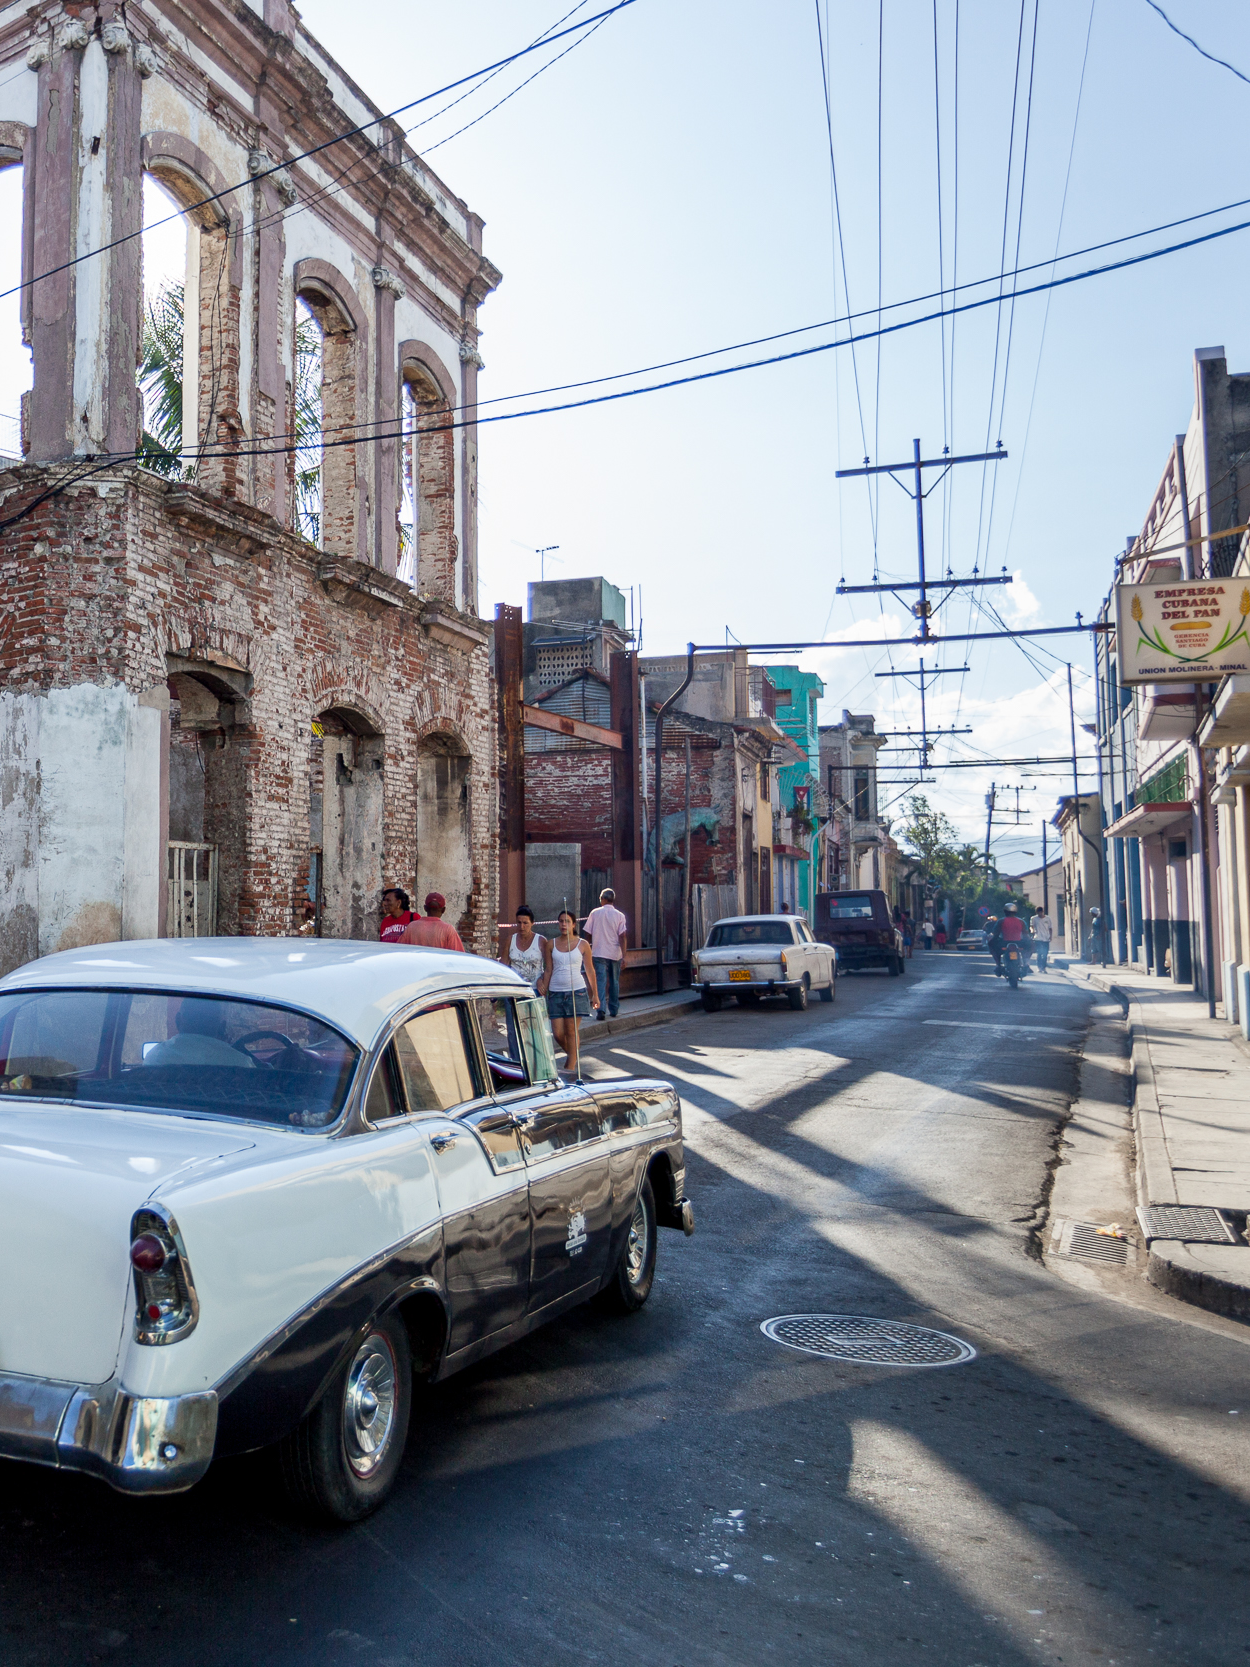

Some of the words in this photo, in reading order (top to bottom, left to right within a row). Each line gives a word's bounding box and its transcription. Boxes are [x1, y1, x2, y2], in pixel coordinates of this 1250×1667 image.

[1154, 587, 1225, 598] EMPRESA
[1162, 598, 1219, 609] CUBANA
[1161, 611, 1189, 620] DEL
[1193, 608, 1221, 618] PAN
[1138, 667, 1166, 675] UNION
[1168, 665, 1214, 673] MOLINERA
